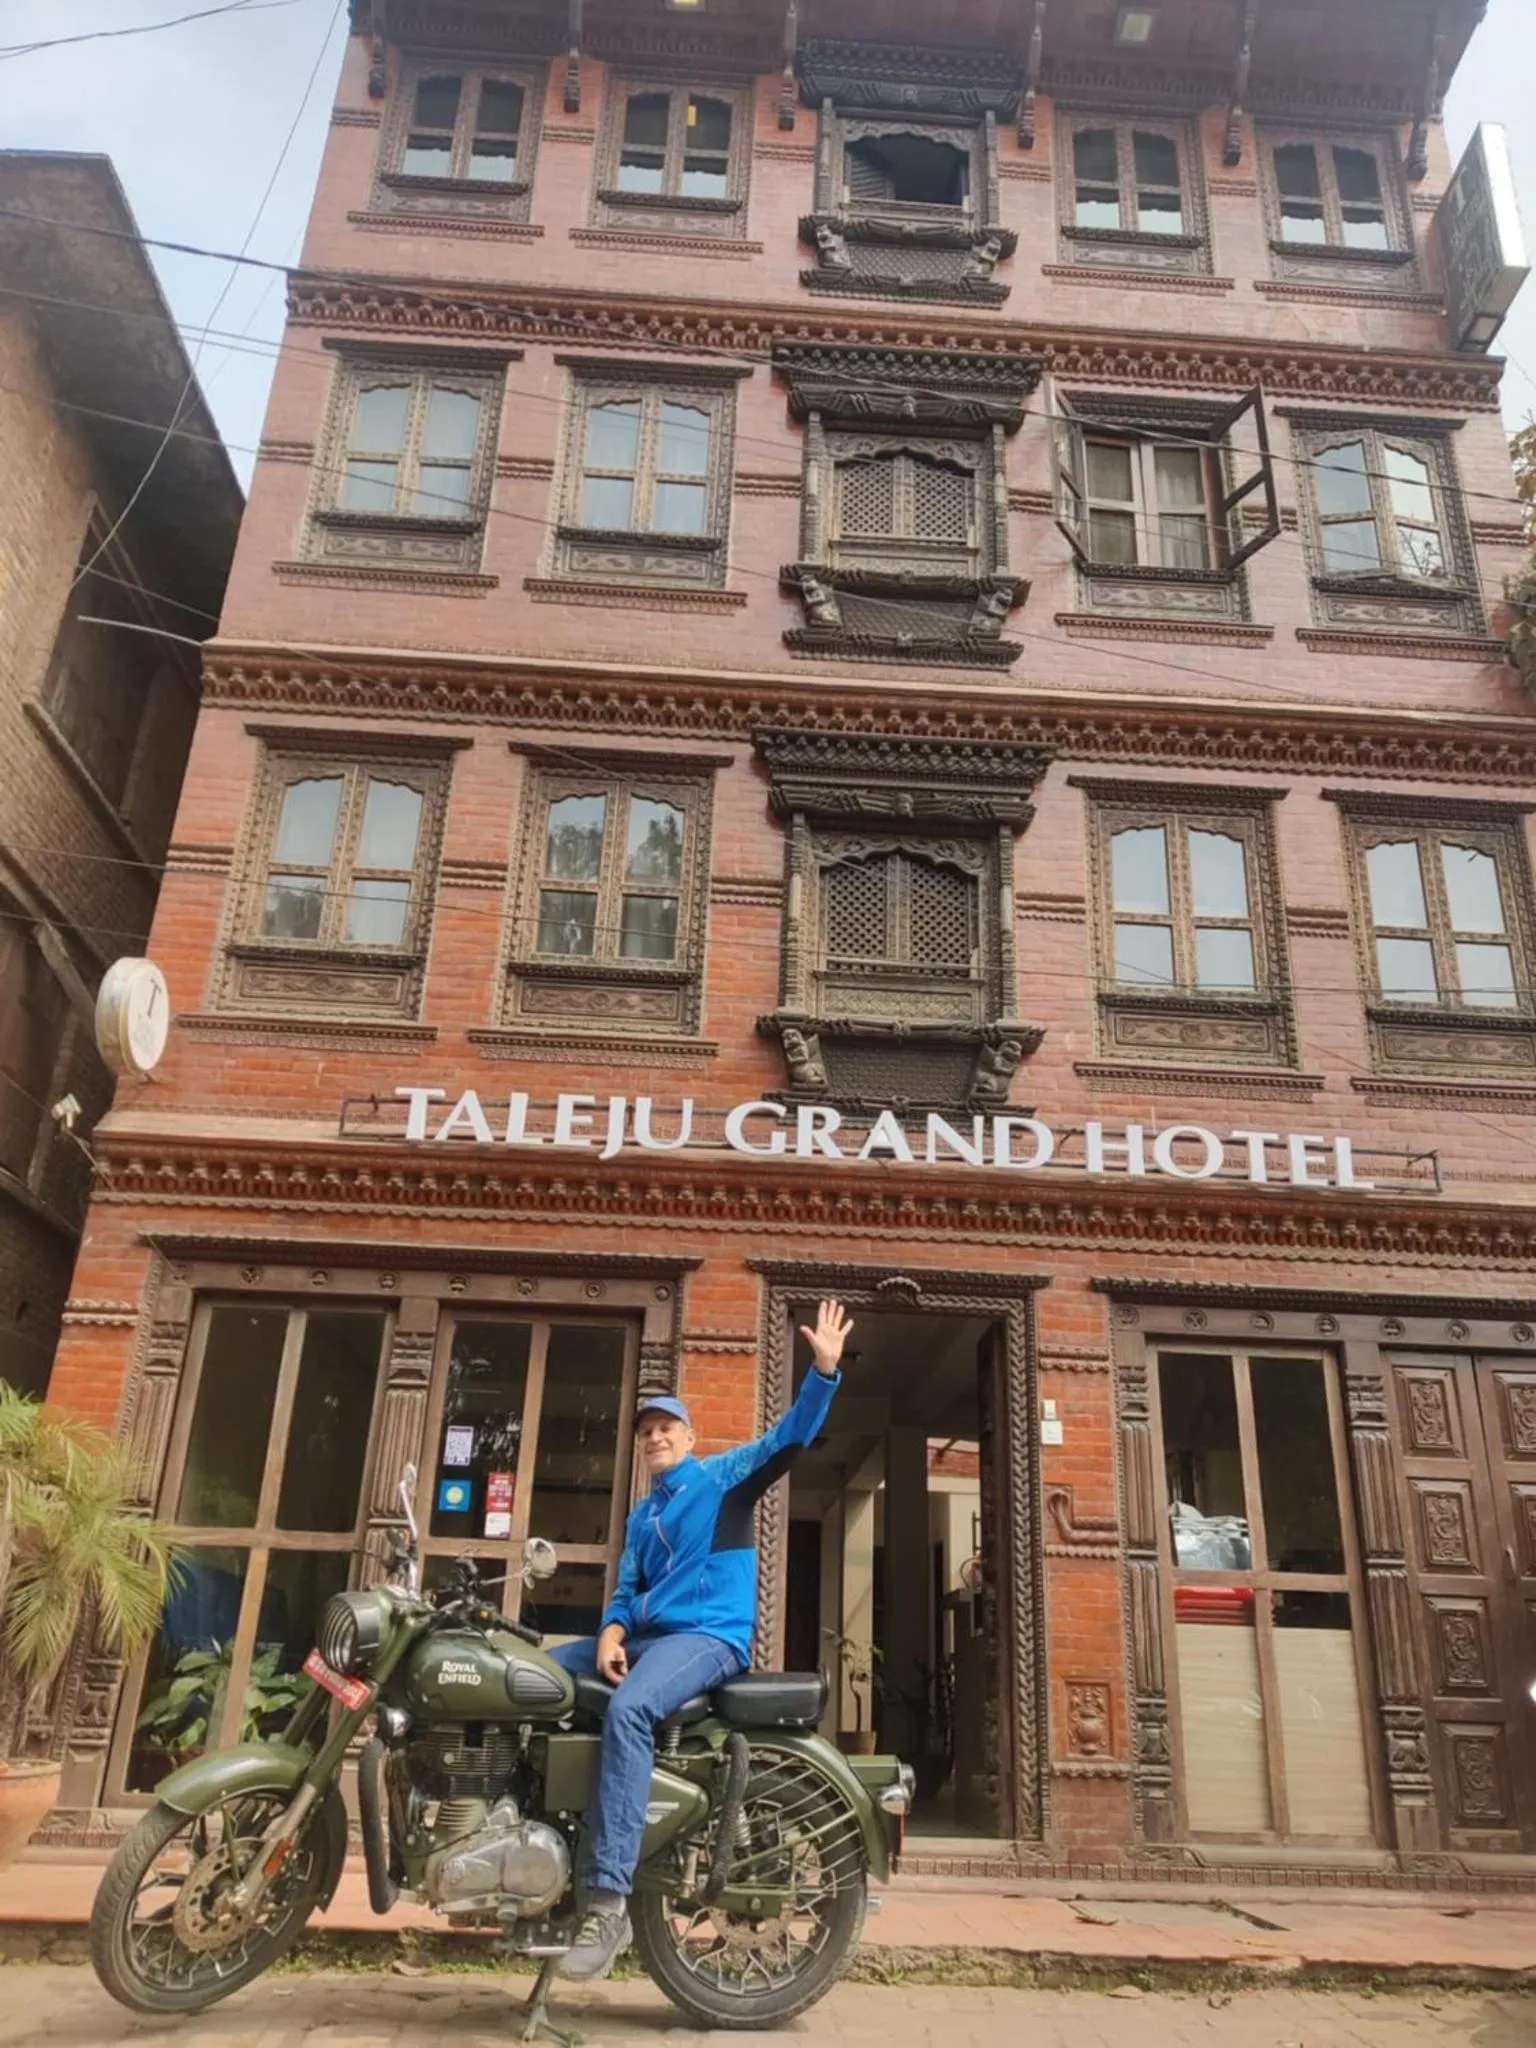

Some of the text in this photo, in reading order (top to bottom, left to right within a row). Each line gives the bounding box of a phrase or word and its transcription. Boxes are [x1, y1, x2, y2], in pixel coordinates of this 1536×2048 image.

[395, 1086, 1375, 1190] TALEJU GRAND HOTEL
[442, 1660, 477, 1673] ROYAL
[438, 1672, 482, 1686] ENFIELD
